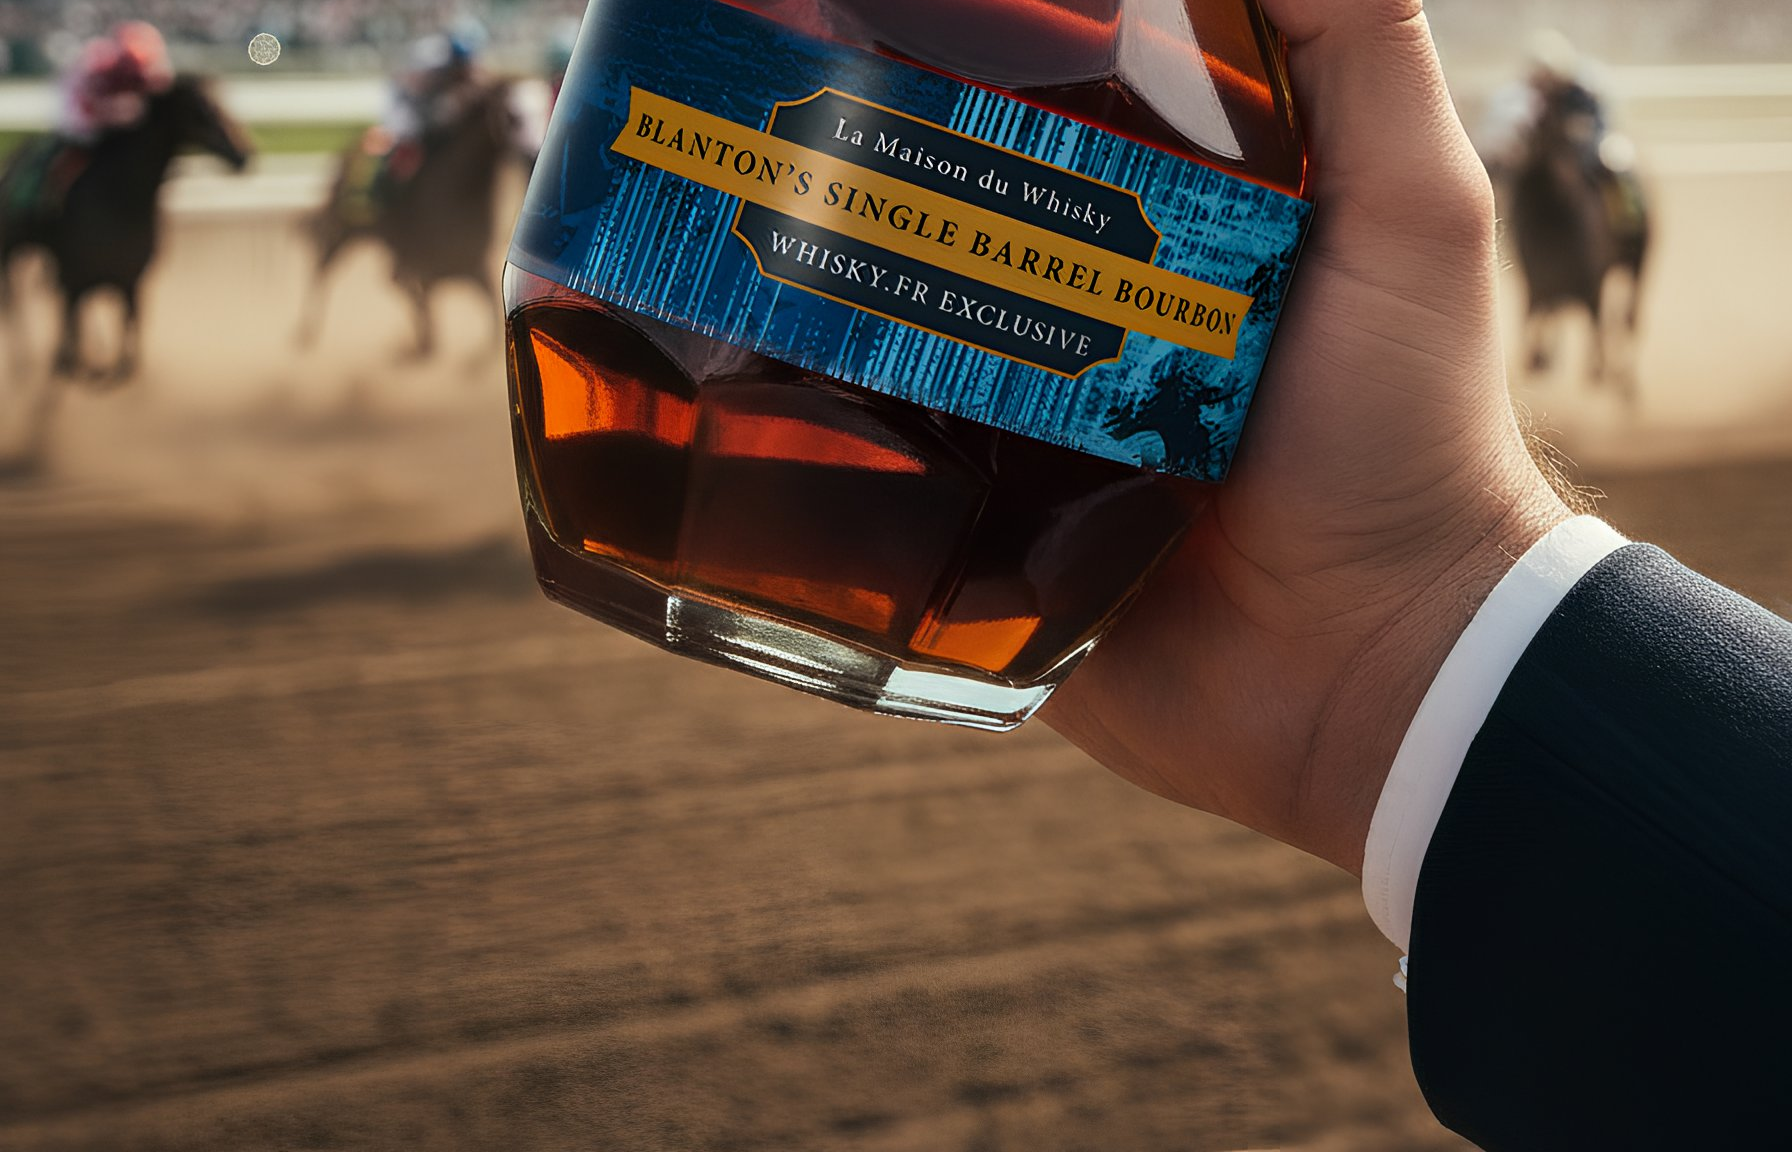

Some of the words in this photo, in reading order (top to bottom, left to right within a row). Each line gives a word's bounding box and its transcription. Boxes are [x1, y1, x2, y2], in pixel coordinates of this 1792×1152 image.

[636, 113, 813, 195] BLANTON'S
[824, 182, 959, 247] SINGLE
[969, 230, 1104, 296] BARREL
[1114, 278, 1238, 336] BOURBON
[832, 116, 863, 146] La
[874, 132, 968, 182] Maison
[978, 170, 1009, 195] du
[1023, 181, 1111, 234] Whisky
[771, 231, 929, 305] WHISKY.FR
[939, 291, 1092, 358] EXCLUSIVE
